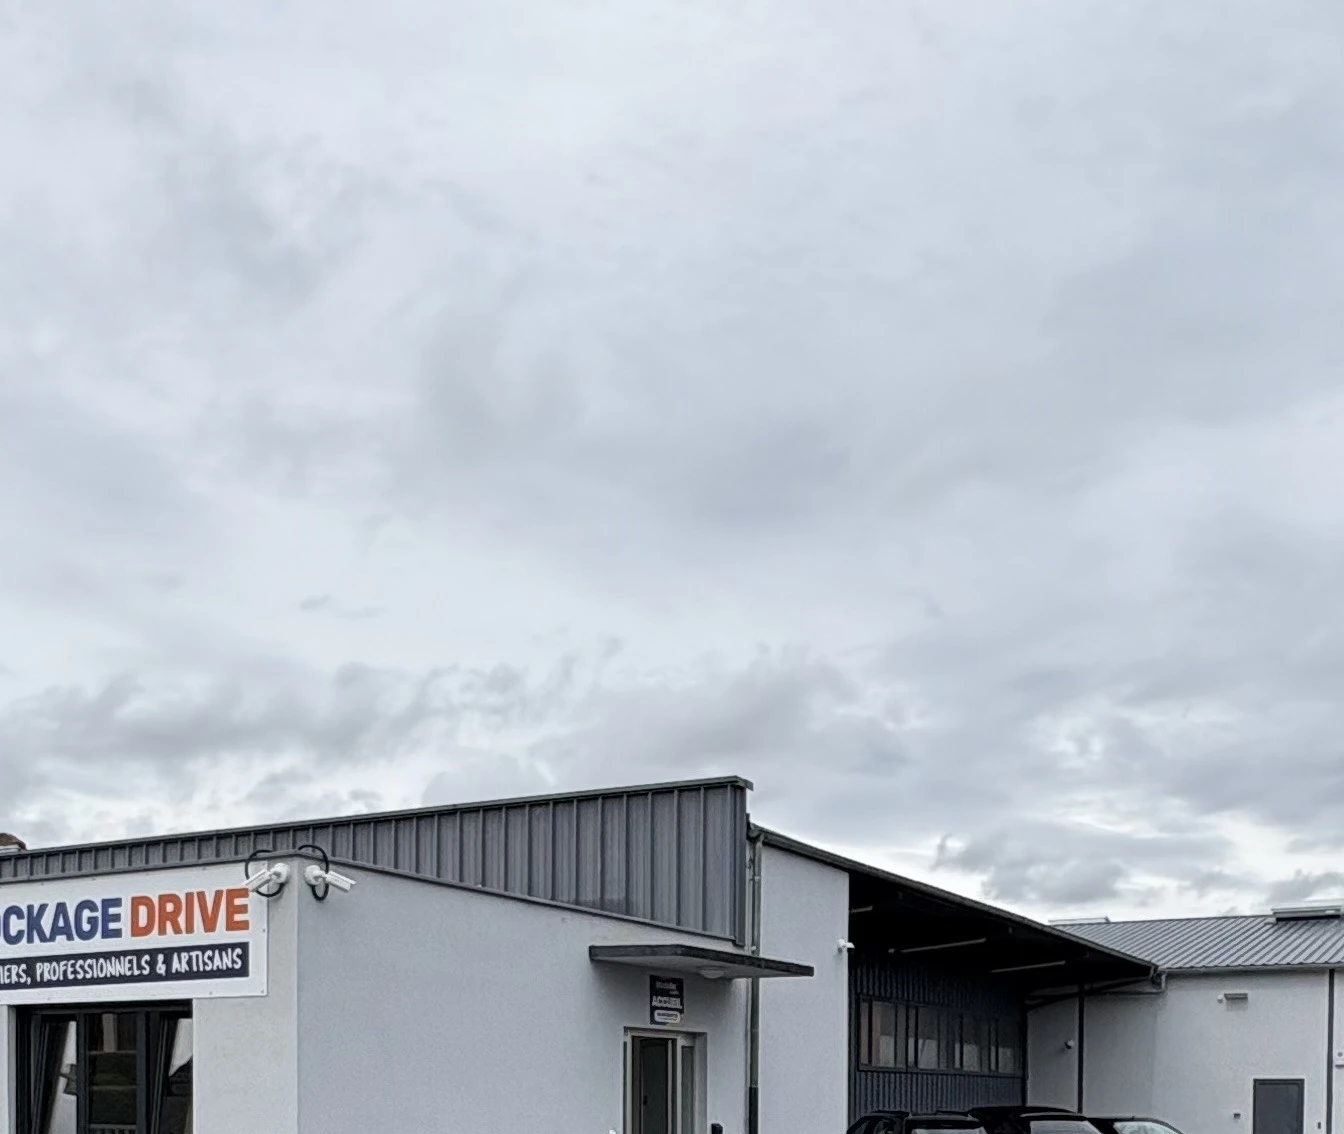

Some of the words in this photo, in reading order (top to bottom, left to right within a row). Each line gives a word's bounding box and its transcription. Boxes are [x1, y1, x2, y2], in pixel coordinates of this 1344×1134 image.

[130, 887, 250, 938] DRIVE
[36, 953, 151, 983] PROFESSIONNELS
[156, 957, 167, 976] &
[171, 947, 243, 974] ARTISANS
